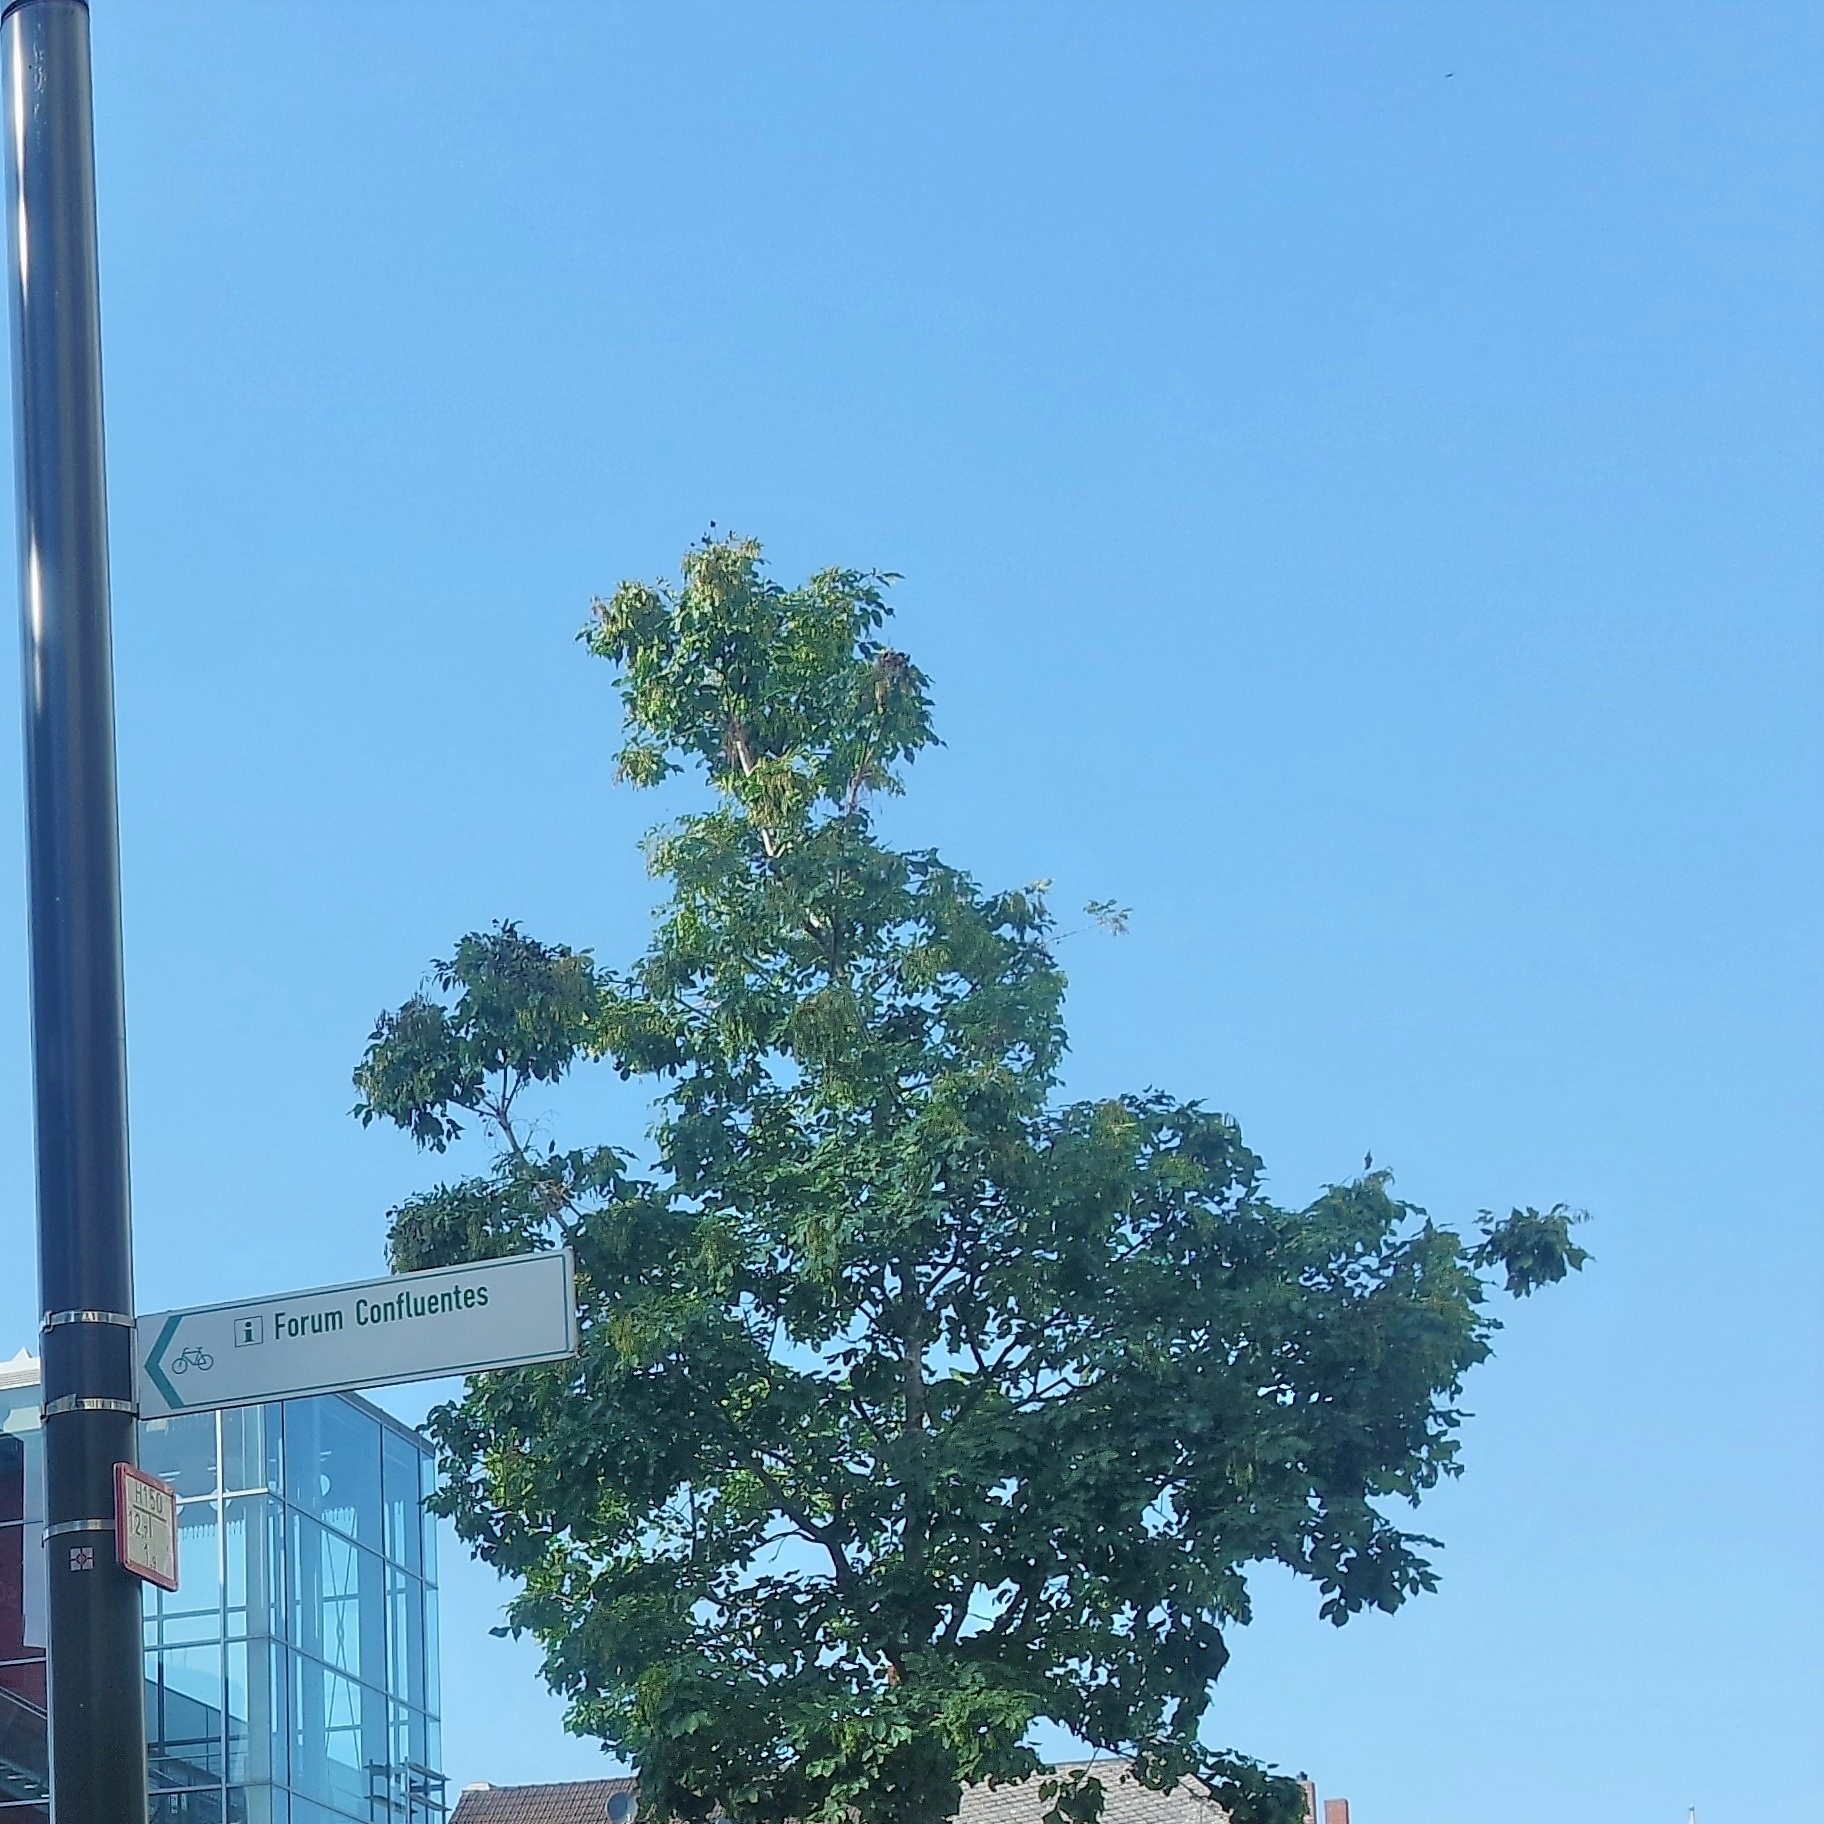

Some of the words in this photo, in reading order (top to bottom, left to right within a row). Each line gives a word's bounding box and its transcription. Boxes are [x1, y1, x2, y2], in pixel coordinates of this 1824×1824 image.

[274, 1308, 344, 1340] Forum
[355, 1283, 490, 1328] Confluentes
[135, 1481, 163, 1514] H150
